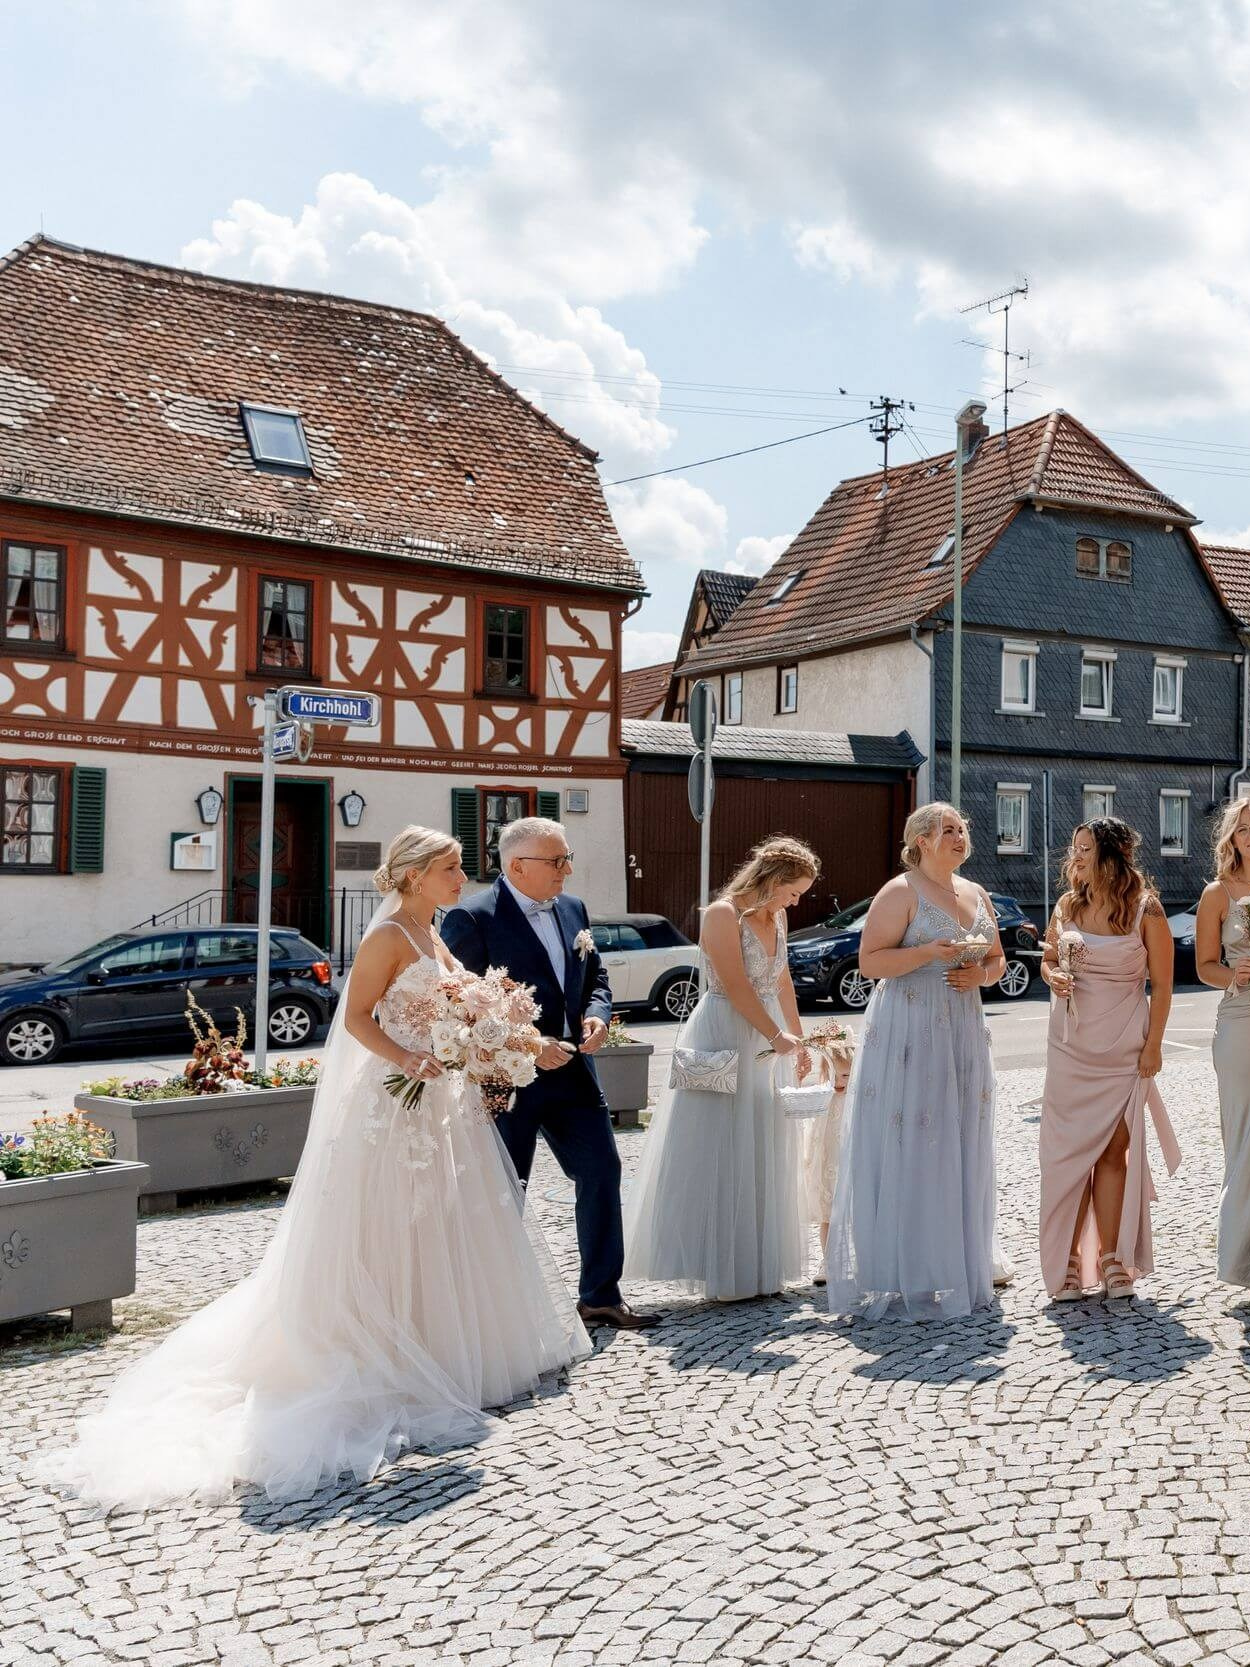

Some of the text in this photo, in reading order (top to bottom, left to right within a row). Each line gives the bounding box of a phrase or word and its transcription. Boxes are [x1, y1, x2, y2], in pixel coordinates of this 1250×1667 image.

[300, 696, 362, 716] Kirchhohl
[0, 729, 20, 737] OCH
[149, 741, 172, 749] NACH
[196, 744, 231, 753] GROSSEN
[628, 854, 637, 867] 2
[634, 868, 643, 879] a
